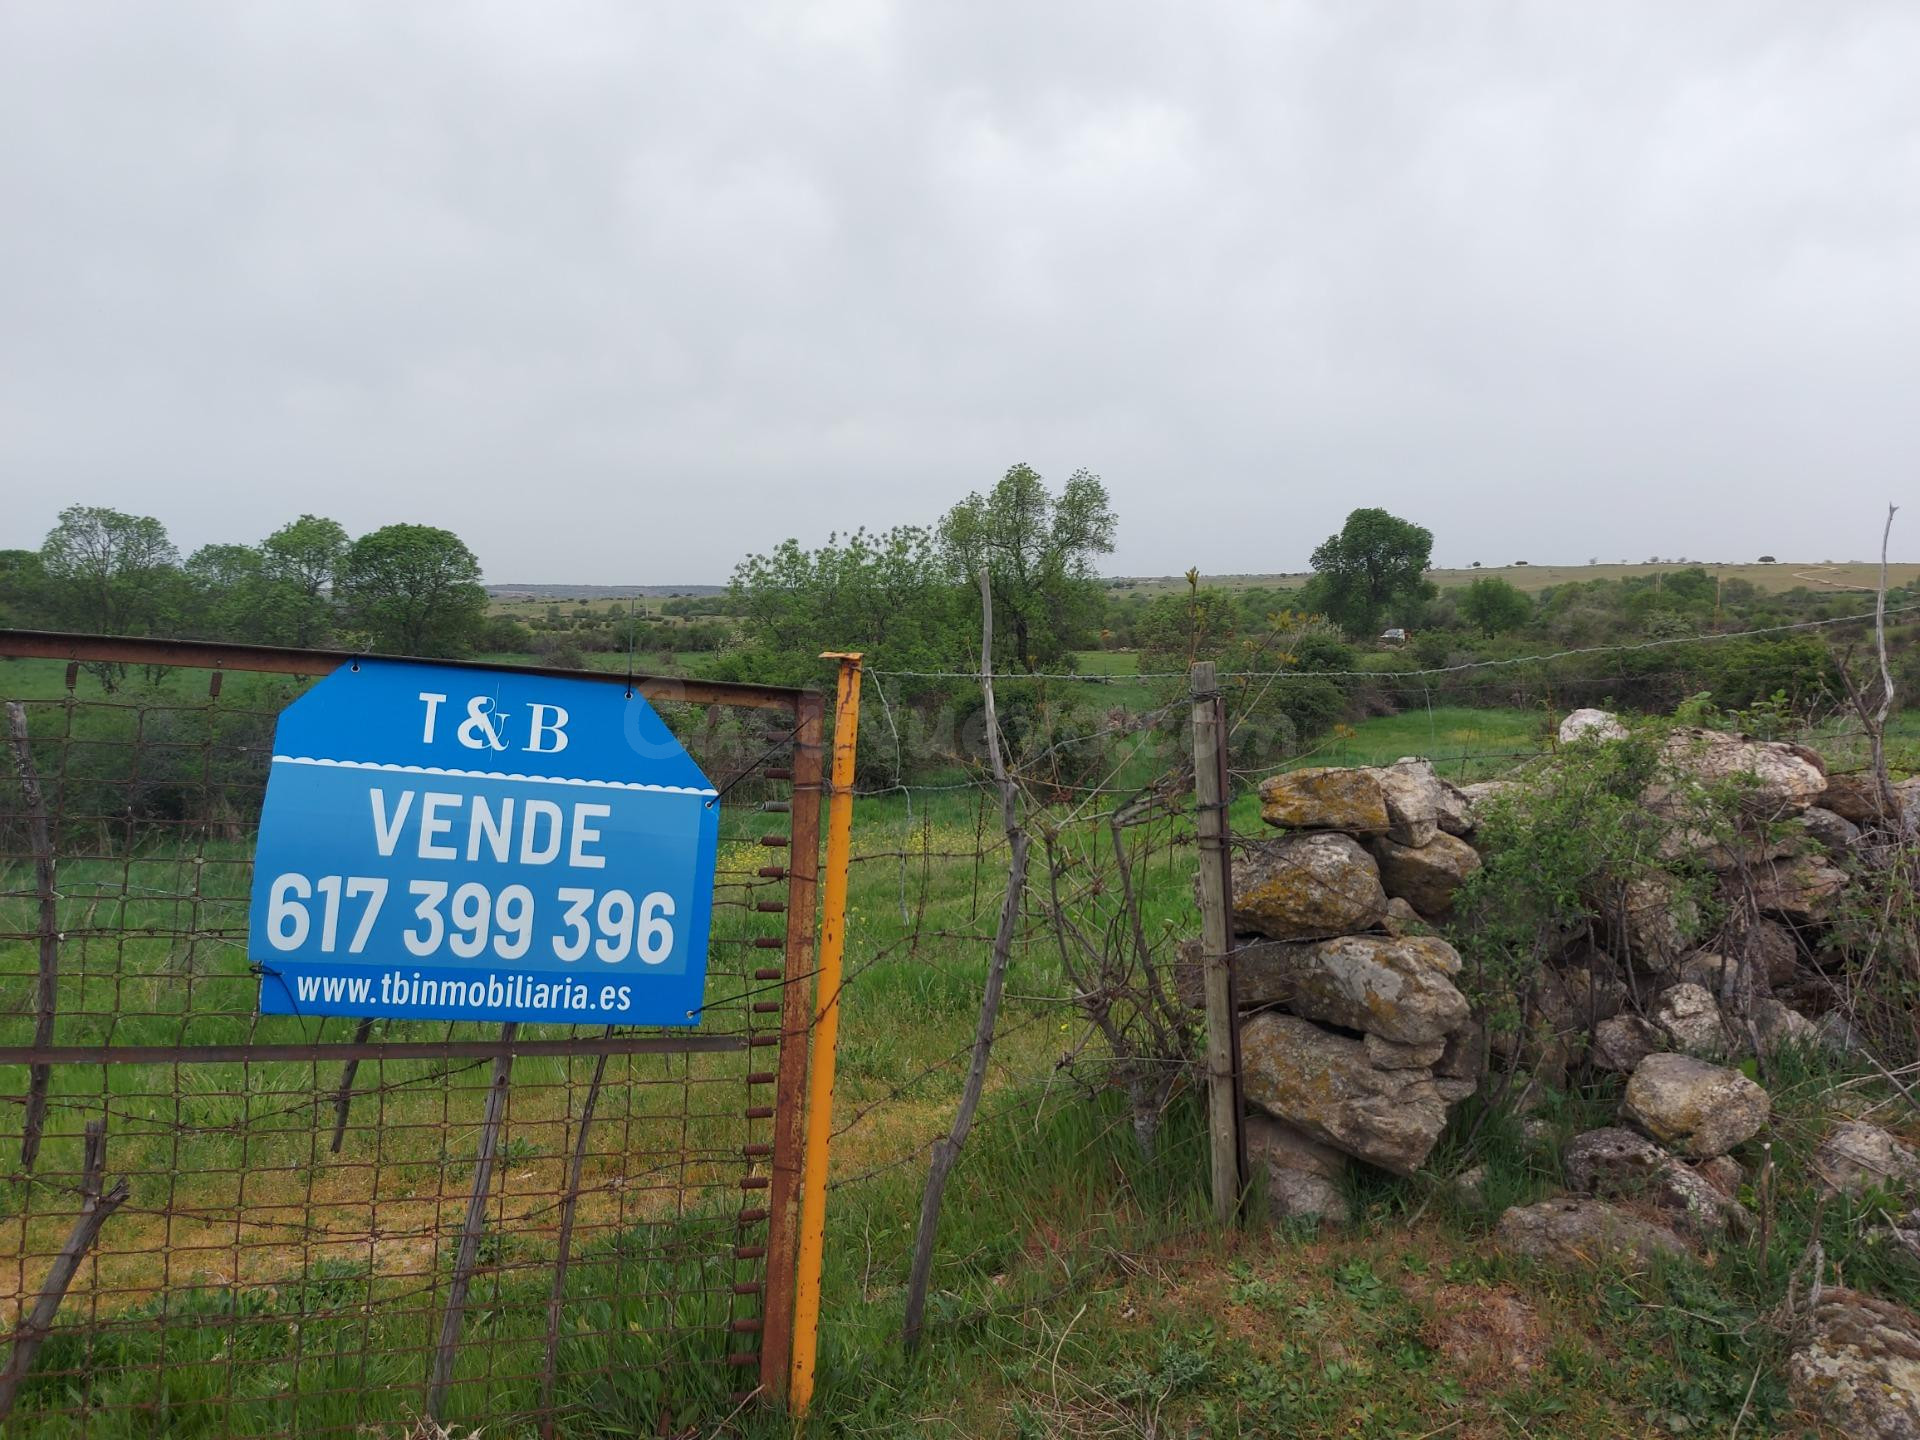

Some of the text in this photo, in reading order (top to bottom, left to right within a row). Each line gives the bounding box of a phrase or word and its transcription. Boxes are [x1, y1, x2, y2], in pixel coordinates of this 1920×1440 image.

[419, 692, 569, 753] T & B
[369, 788, 611, 868] VENDE
[267, 873, 676, 965] 617 399 396
[297, 971, 632, 1011] www.tbinmobiliaria.es
